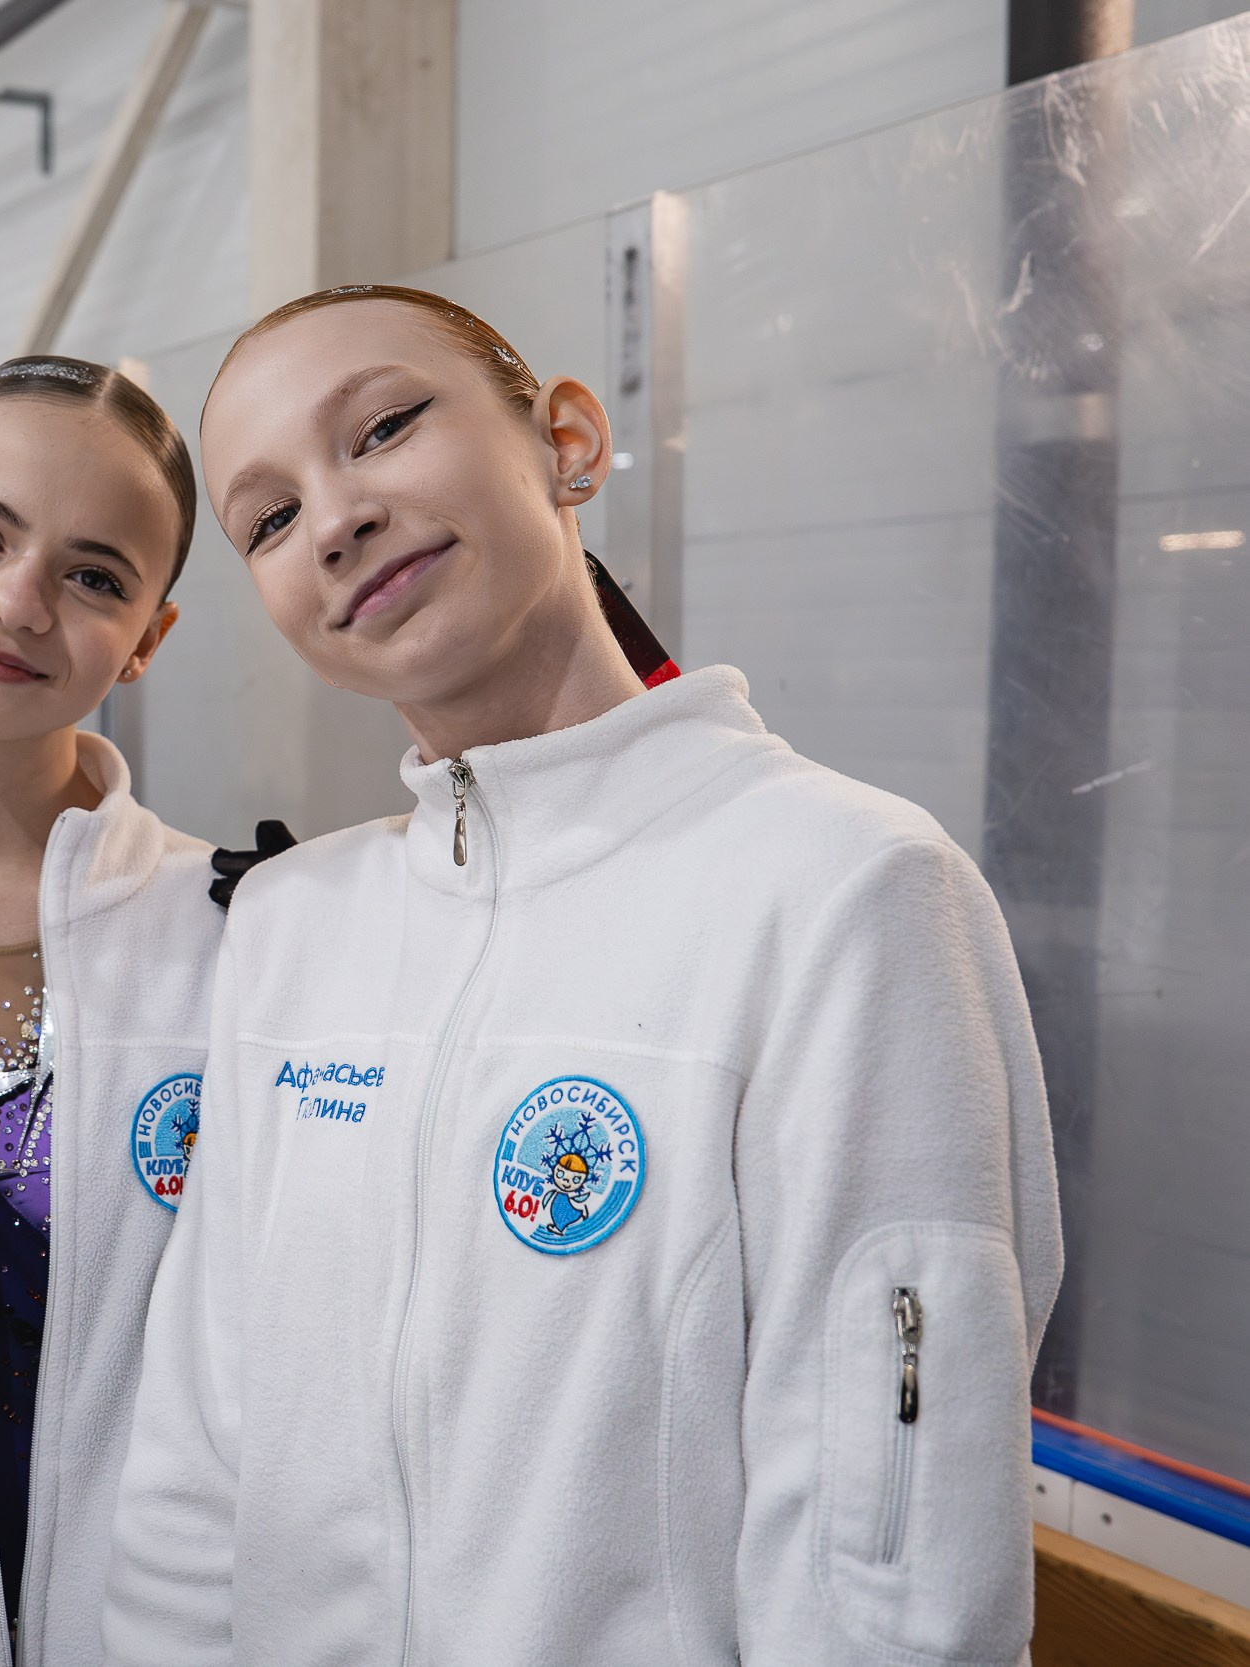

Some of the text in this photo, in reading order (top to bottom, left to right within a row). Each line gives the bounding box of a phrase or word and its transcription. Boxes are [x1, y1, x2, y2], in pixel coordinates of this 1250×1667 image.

[138, 1080, 202, 1137] НОВОСИБ
[510, 1085, 637, 1174] НОВОСИБИРСК
[146, 1158, 184, 1176] КЛУБ
[501, 1165, 546, 1197] КЛУБ
[503, 1190, 540, 1222] 6.0!
